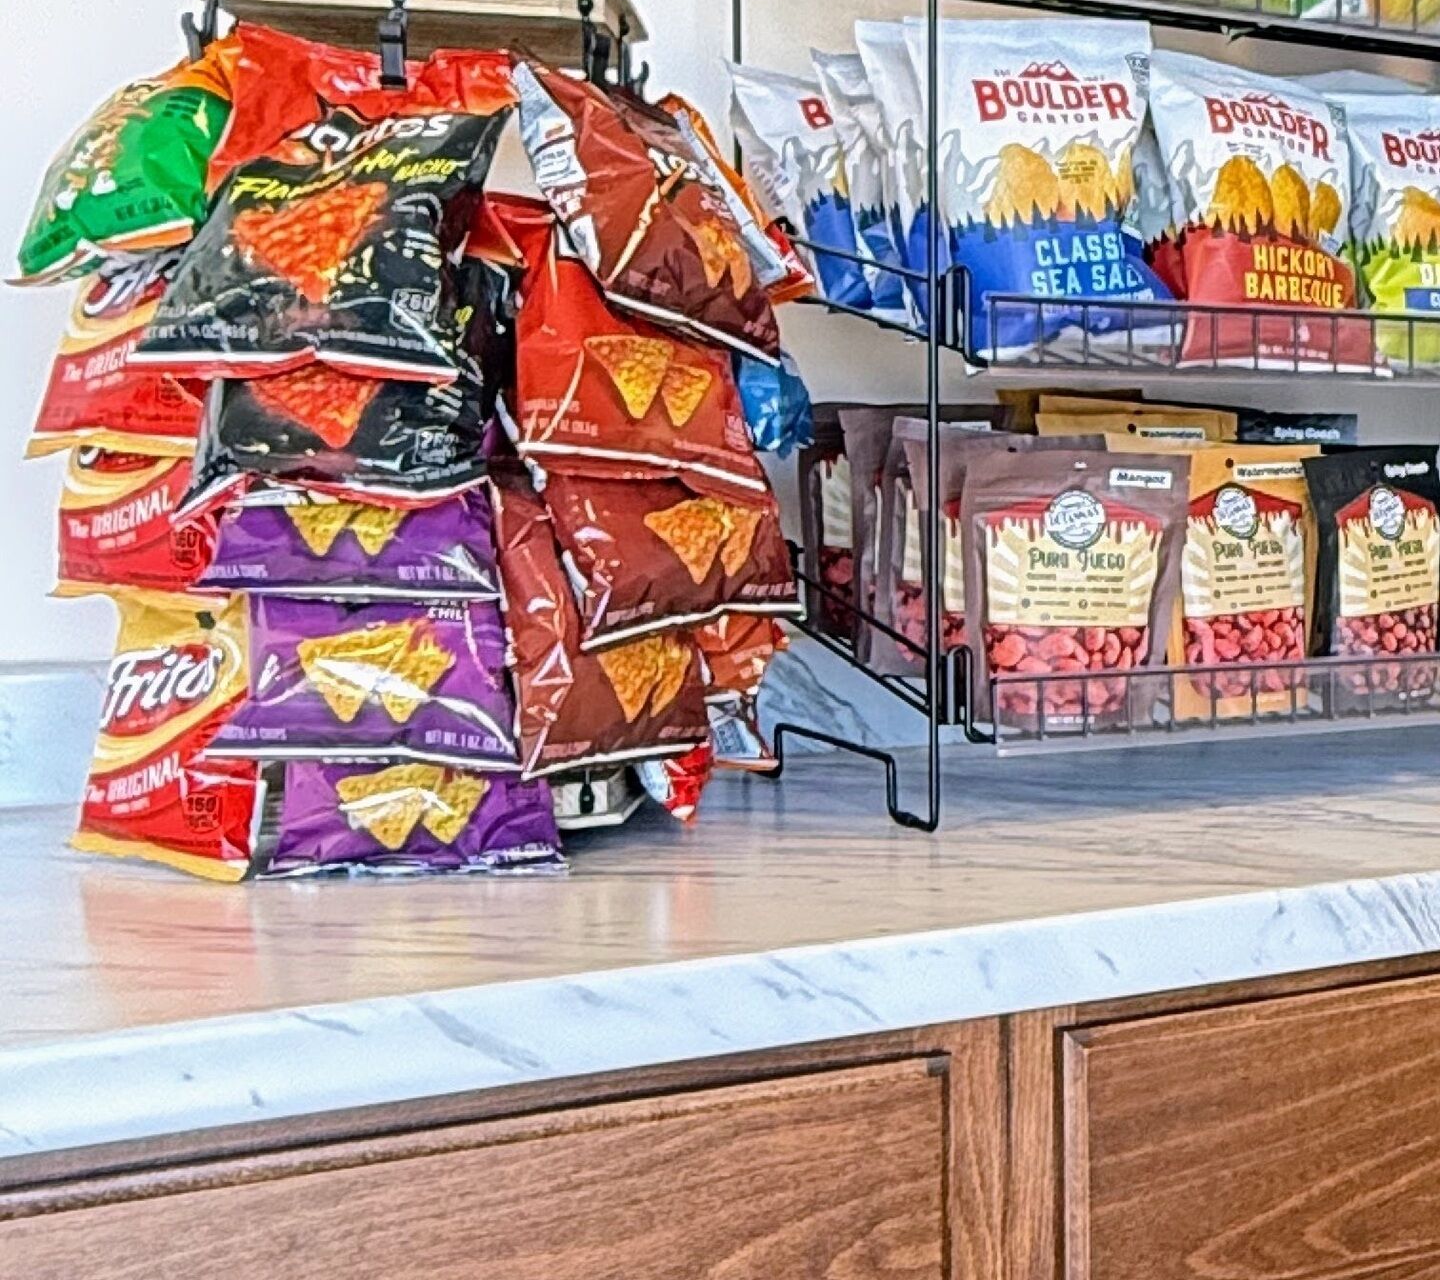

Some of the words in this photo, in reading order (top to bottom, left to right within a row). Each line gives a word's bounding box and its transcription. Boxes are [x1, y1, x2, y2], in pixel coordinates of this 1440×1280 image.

[972, 79, 1136, 122] BOULDER
[1017, 111, 1099, 124] CANYON
[1204, 96, 1334, 163] BOULDER
[1035, 232, 1126, 268] CLASSI
[1253, 244, 1335, 280] HICKORY
[1031, 267, 1083, 296] SEA
[1244, 272, 1345, 309] BARBEQUE
[69, 519, 89, 538] The
[91, 485, 174, 537] ORIGINAL
[101, 646, 224, 730] Fritos
[107, 751, 184, 802] ORIGINAL
